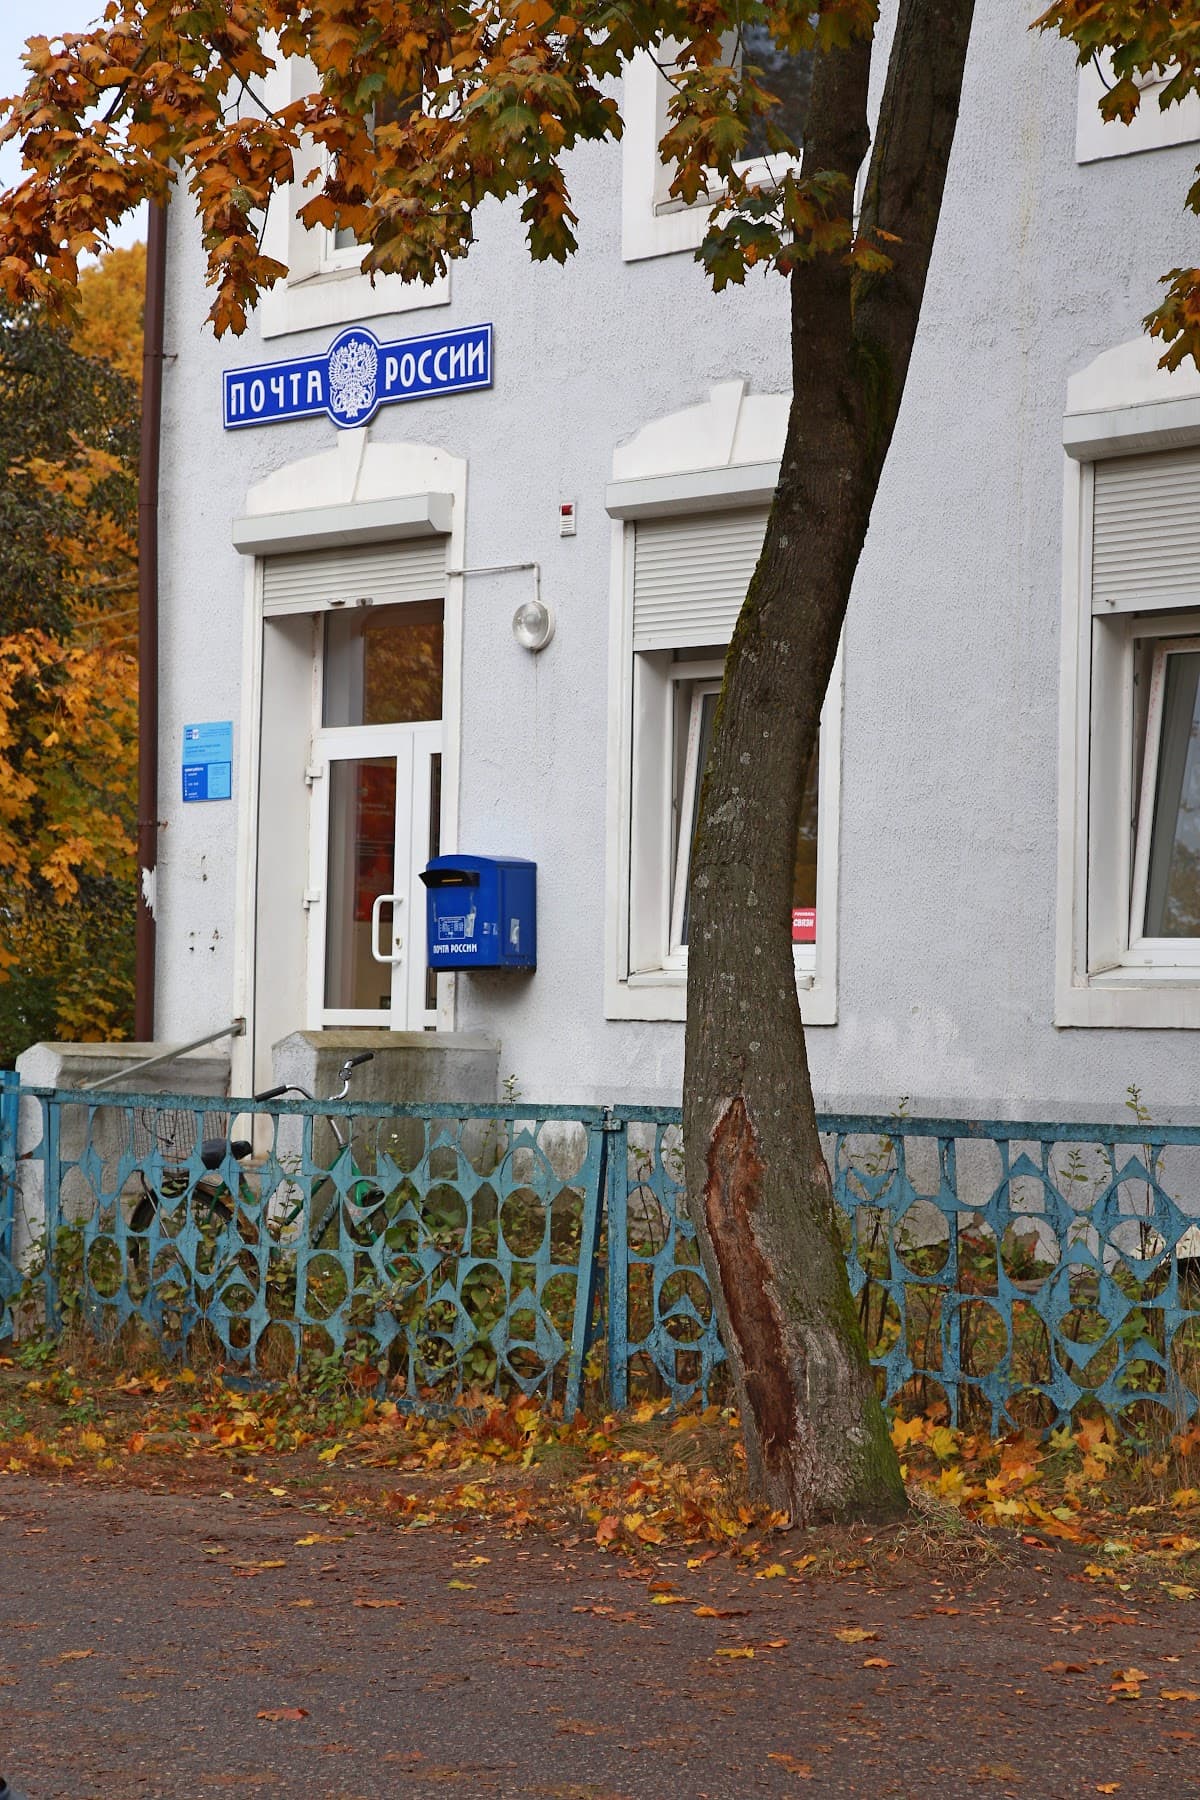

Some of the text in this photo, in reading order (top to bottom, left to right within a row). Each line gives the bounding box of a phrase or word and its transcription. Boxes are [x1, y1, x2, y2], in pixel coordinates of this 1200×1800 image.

[231, 339, 485, 416] ПОЧТА РОССИИ
[450, 944, 477, 953] РОССИИ
